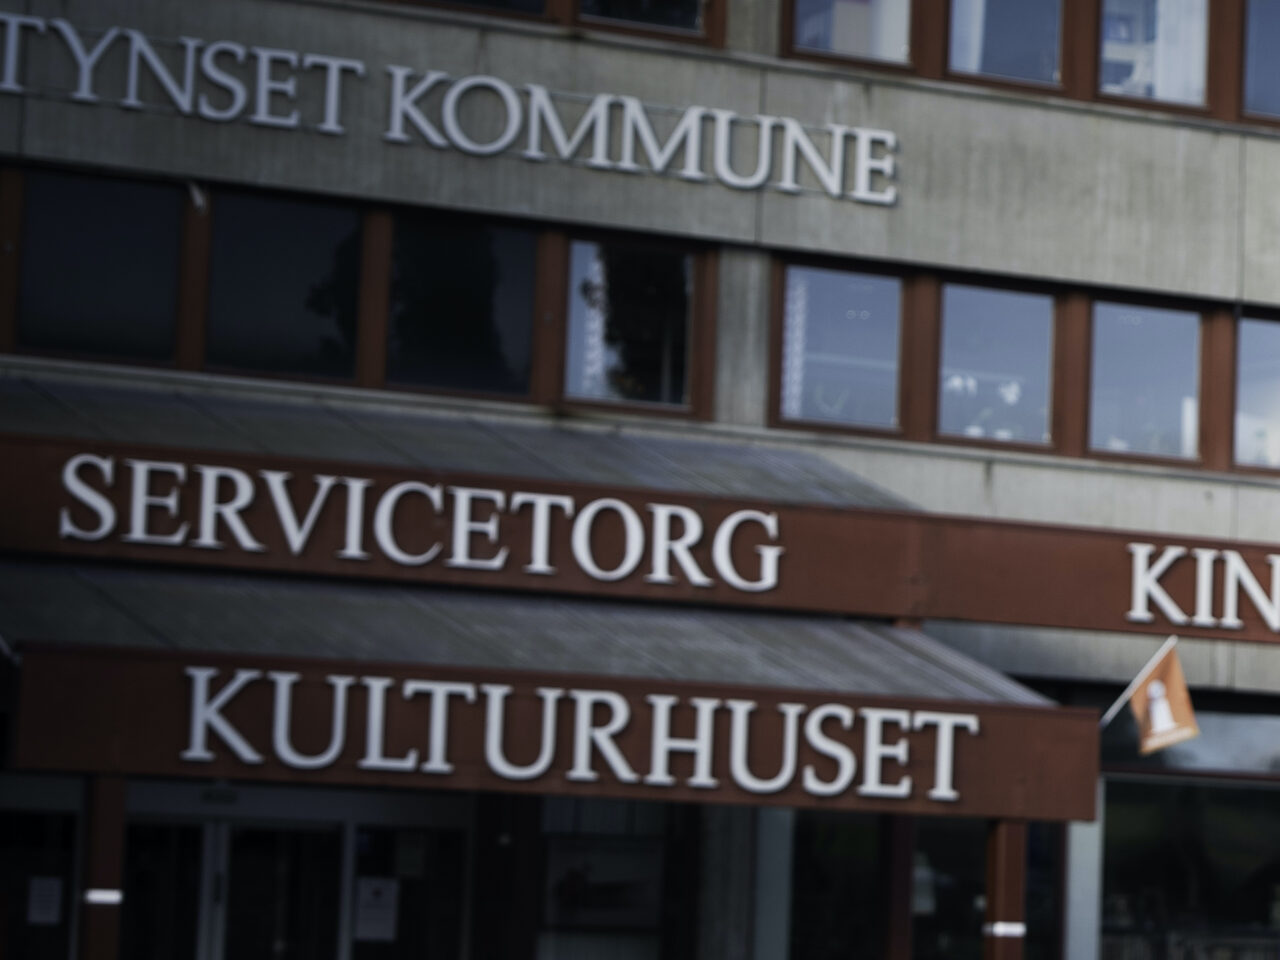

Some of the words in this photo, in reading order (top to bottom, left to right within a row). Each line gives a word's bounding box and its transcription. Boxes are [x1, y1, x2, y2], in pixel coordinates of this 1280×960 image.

[0, 11, 364, 134] TYNSET
[386, 65, 897, 205] KOMMUNE
[59, 453, 784, 592] SERVICETORG
[183, 666, 979, 800] KULTURHUSET
